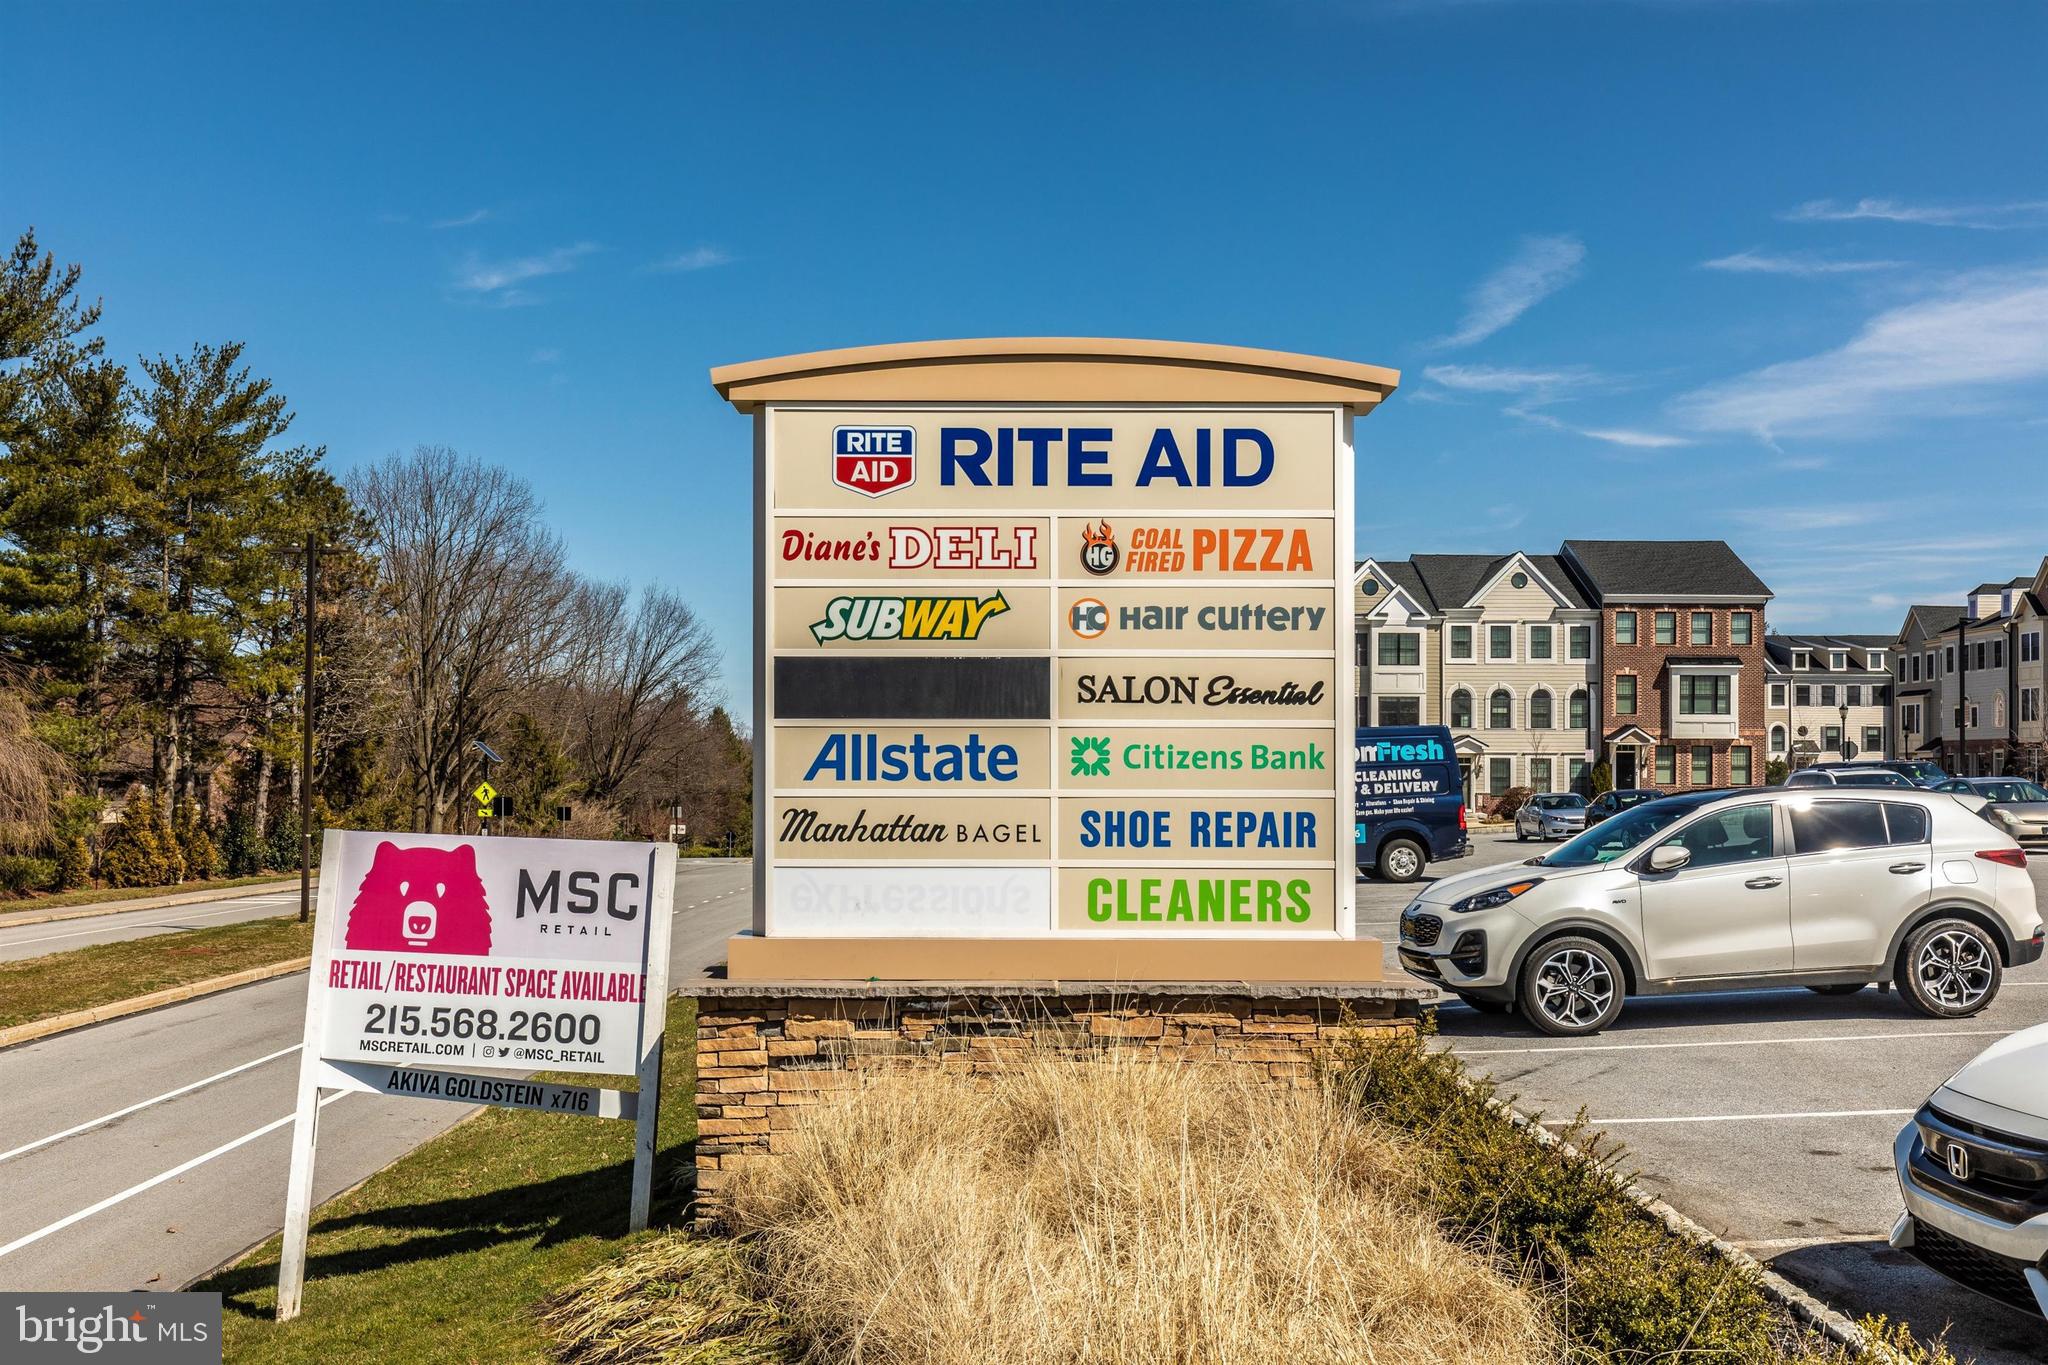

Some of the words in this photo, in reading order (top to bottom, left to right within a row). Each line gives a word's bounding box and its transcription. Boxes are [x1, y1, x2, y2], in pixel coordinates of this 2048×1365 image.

[847, 432, 902, 453] RITE
[940, 427, 1113, 487] RITE
[1135, 427, 1275, 487] AID
[850, 461, 899, 483] AID
[782, 529, 880, 562] Diane's
[889, 527, 1037, 569] DELI
[1131, 528, 1184, 549] COAL
[1193, 529, 1313, 571] PIZZA
[1086, 546, 1113, 566] HG
[1125, 551, 1185, 572] FIRED
[815, 594, 1006, 642] SUBWAY
[1072, 605, 1107, 631] HC
[1199, 604, 1326, 640] cuttery
[1077, 676, 1199, 704] SALON
[1203, 675, 1324, 706] Essential
[803, 733, 1018, 782] Allstate
[1123, 743, 1243, 770] Citizens
[1252, 745, 1325, 770] Bank
[1361, 784, 1371, 795] &
[1374, 781, 1438, 794] DELIVERY
[780, 808, 948, 843] Manhattan
[957, 824, 1041, 843] BAGEL
[1080, 810, 1171, 848] SHOE
[1190, 811, 1317, 848] REPAIR
[516, 868, 639, 921] MSC
[1087, 878, 1311, 923] CLEANERS
[540, 924, 612, 936] RETAIL
[504, 967, 557, 999] SPACE
[364, 1003, 600, 1045] 215.568.2600
[359, 1040, 465, 1056] MSCRETAIL.COM
[513, 1048, 605, 1063] @MSC_RETAIL
[387, 1070, 440, 1095] AKIVA
[445, 1077, 543, 1106] GOLDSTEIN
[551, 1091, 589, 1112] x716
